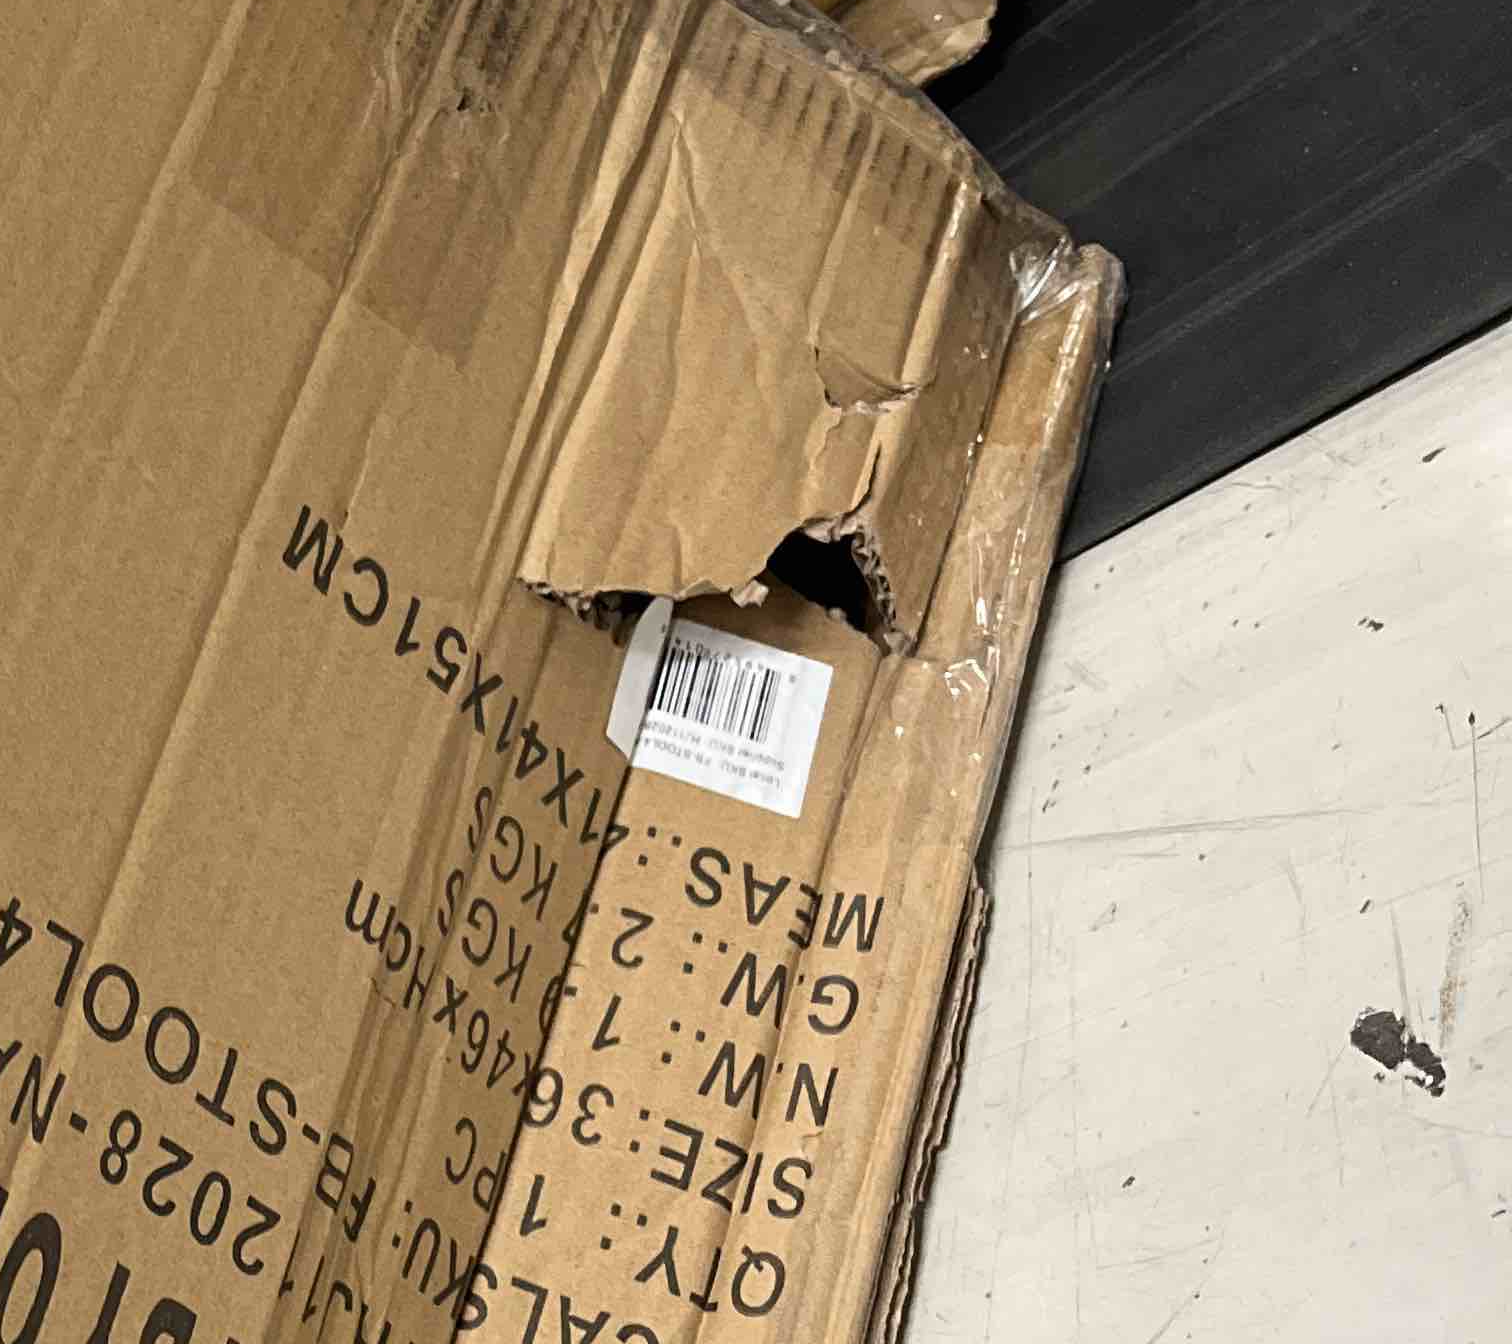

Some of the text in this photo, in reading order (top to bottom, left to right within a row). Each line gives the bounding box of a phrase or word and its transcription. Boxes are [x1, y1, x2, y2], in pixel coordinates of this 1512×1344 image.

[468, 786, 558, 921] KGS
[437, 868, 532, 1004] KGS
[683, 932, 860, 1035] G.W.:
[660, 1020, 839, 1126] N.W.:
[445, 1116, 786, 1317] QTY.: 1 PC
